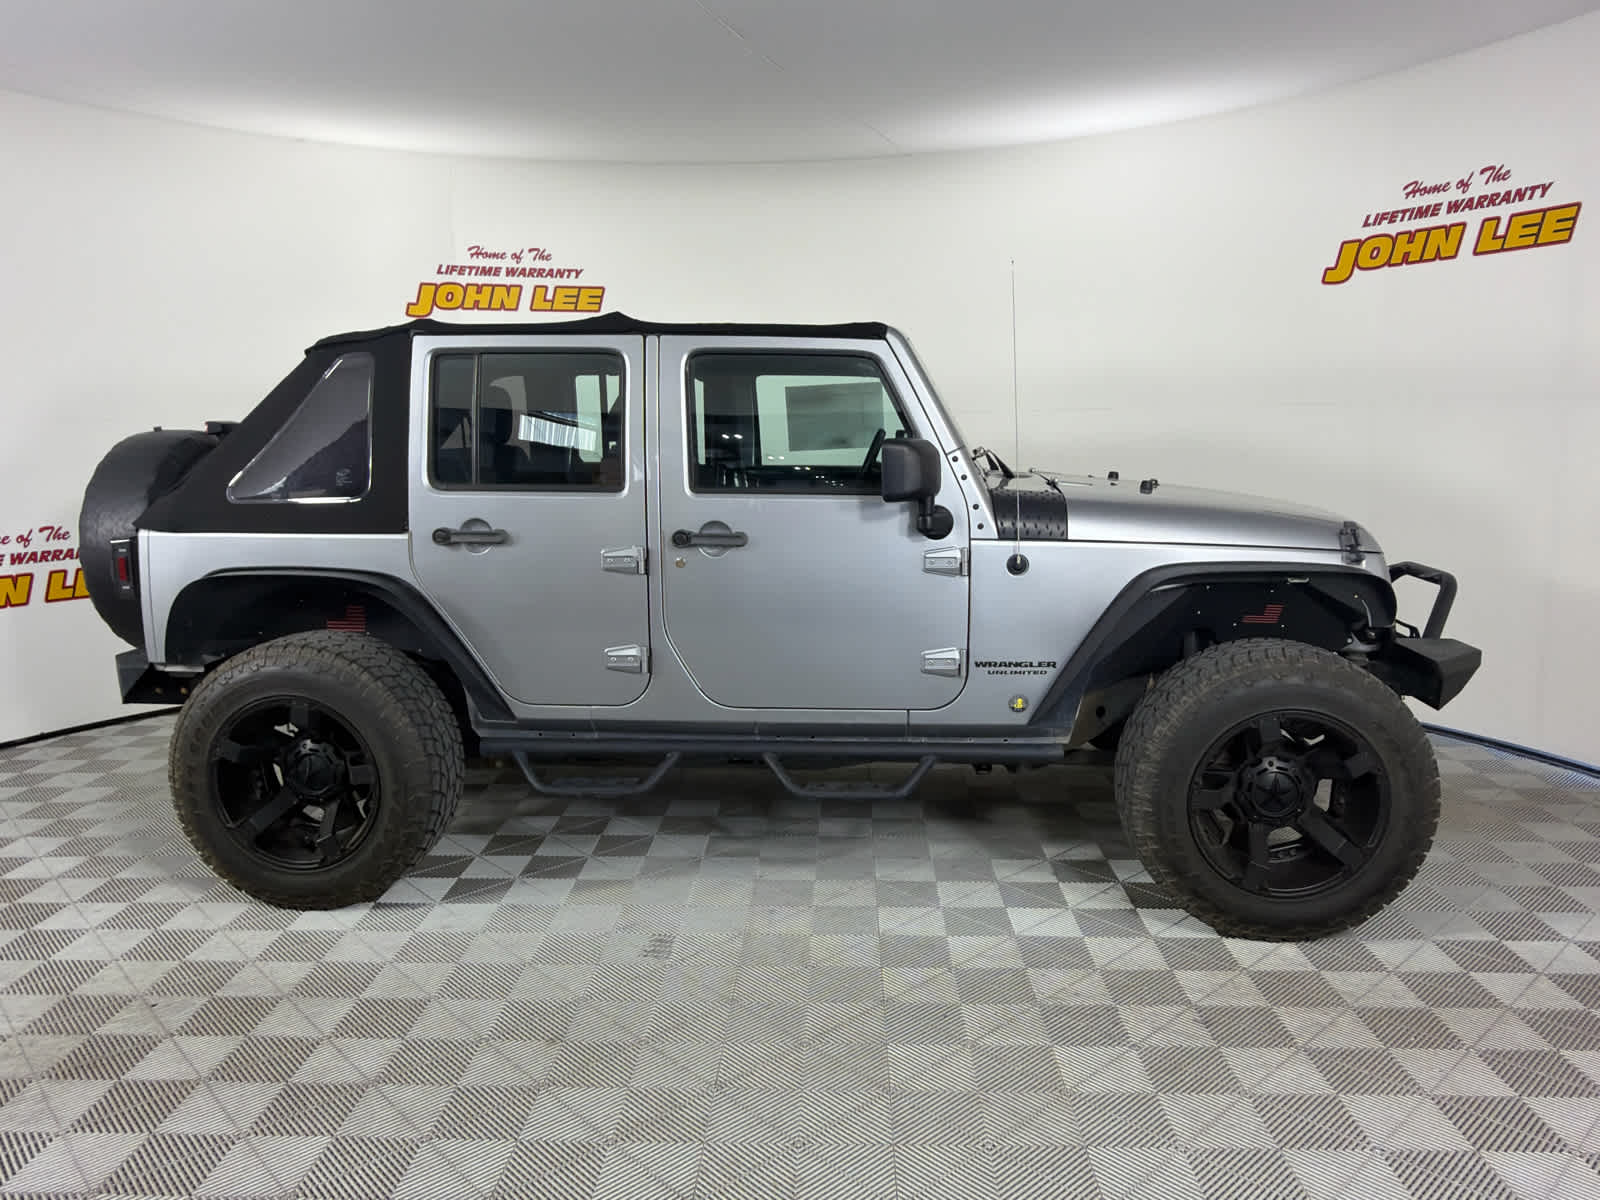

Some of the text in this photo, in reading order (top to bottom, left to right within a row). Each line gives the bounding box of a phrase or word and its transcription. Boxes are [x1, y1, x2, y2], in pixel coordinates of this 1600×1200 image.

[1402, 164, 1512, 200] Home of The
[1361, 181, 1555, 228] LIFETIME WARRANTY
[1321, 201, 1583, 286] JOHN LEE
[467, 245, 553, 265] Home of The
[436, 264, 585, 280] LIFETIME WARRANTY
[405, 281, 605, 318] JOHN LEE
[16, 529, 33, 548] of
[38, 526, 71, 542] The
[10, 548, 80, 565] WARRA
[974, 661, 1057, 669] WRANGLER
